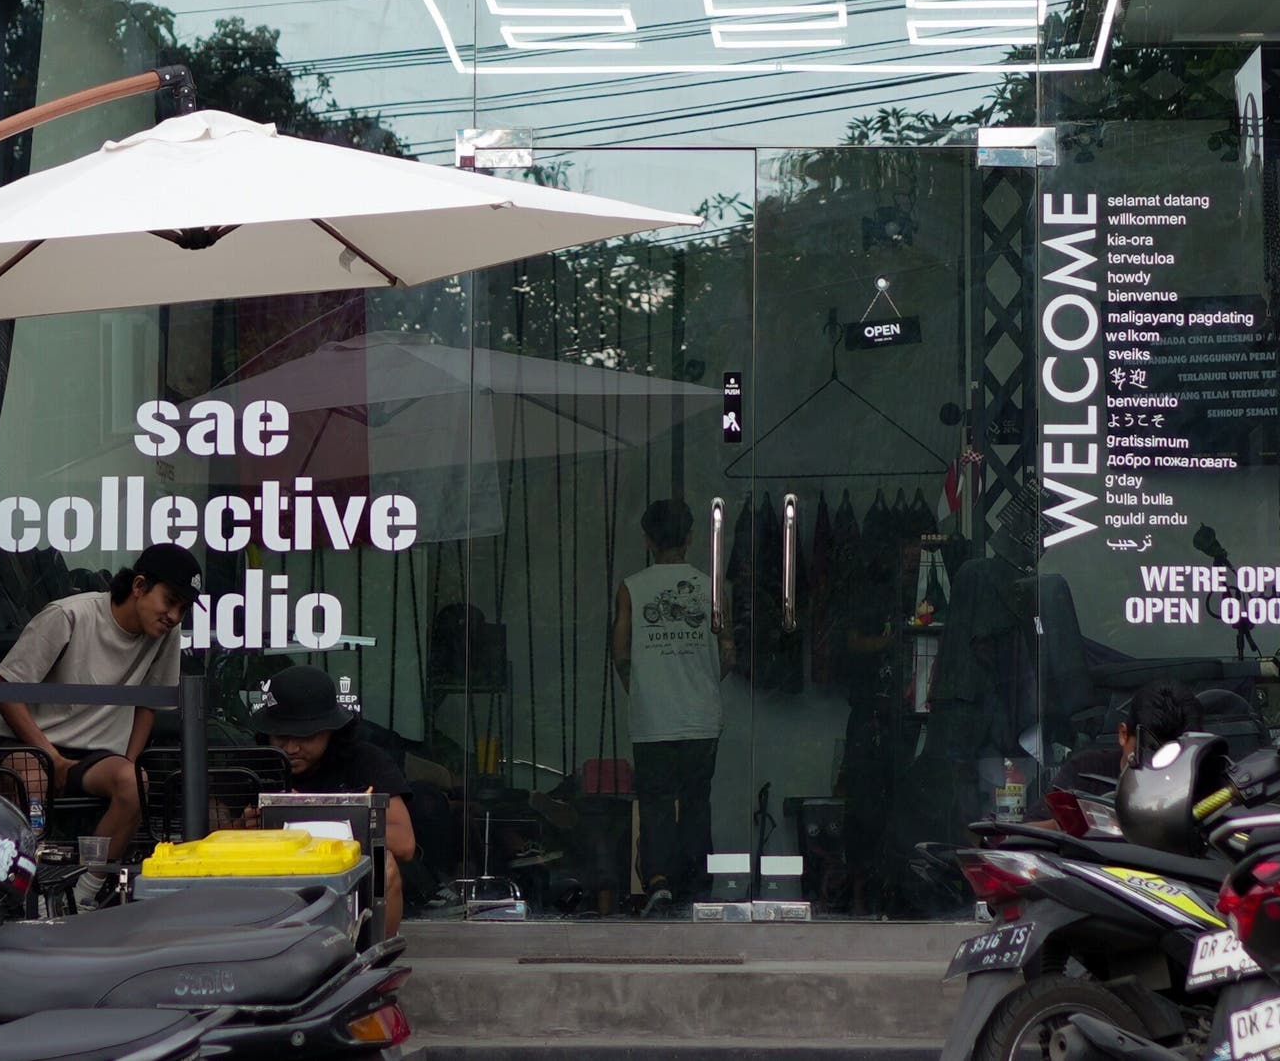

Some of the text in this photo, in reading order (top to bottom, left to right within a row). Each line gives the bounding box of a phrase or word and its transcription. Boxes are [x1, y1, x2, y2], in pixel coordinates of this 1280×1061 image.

[1107, 194, 1210, 209] selamat datang
[1107, 213, 1187, 226] willkommen
[1107, 234, 1154, 246] kia-ora
[1107, 252, 1175, 265] tervetuloa
[1107, 271, 1151, 285] howdy
[1107, 290, 1178, 302] bienvenue
[1107, 311, 1254, 327] maligayang pagdating
[863, 323, 901, 338] OPEN
[1106, 329, 1160, 341] welkom
[1108, 348, 1151, 360] sveiks
[1041, 193, 1098, 548] WELCOME
[724, 388, 741, 396] PUSH
[1107, 395, 1178, 407] benvenuto
[133, 399, 290, 456] sae
[1107, 414, 1165, 428] ようこそ
[1106, 434, 1189, 449] gratissimum
[1107, 454, 1237, 469] добро пожаловать
[1105, 473, 1142, 488] g'day
[1106, 492, 1173, 506] bulla bulla
[1105, 512, 1188, 526] nguldi amdu
[1106, 534, 1152, 552] ترحيب
[1140, 565, 1227, 593] WE'RE
[1125, 597, 1200, 625] OPEN
